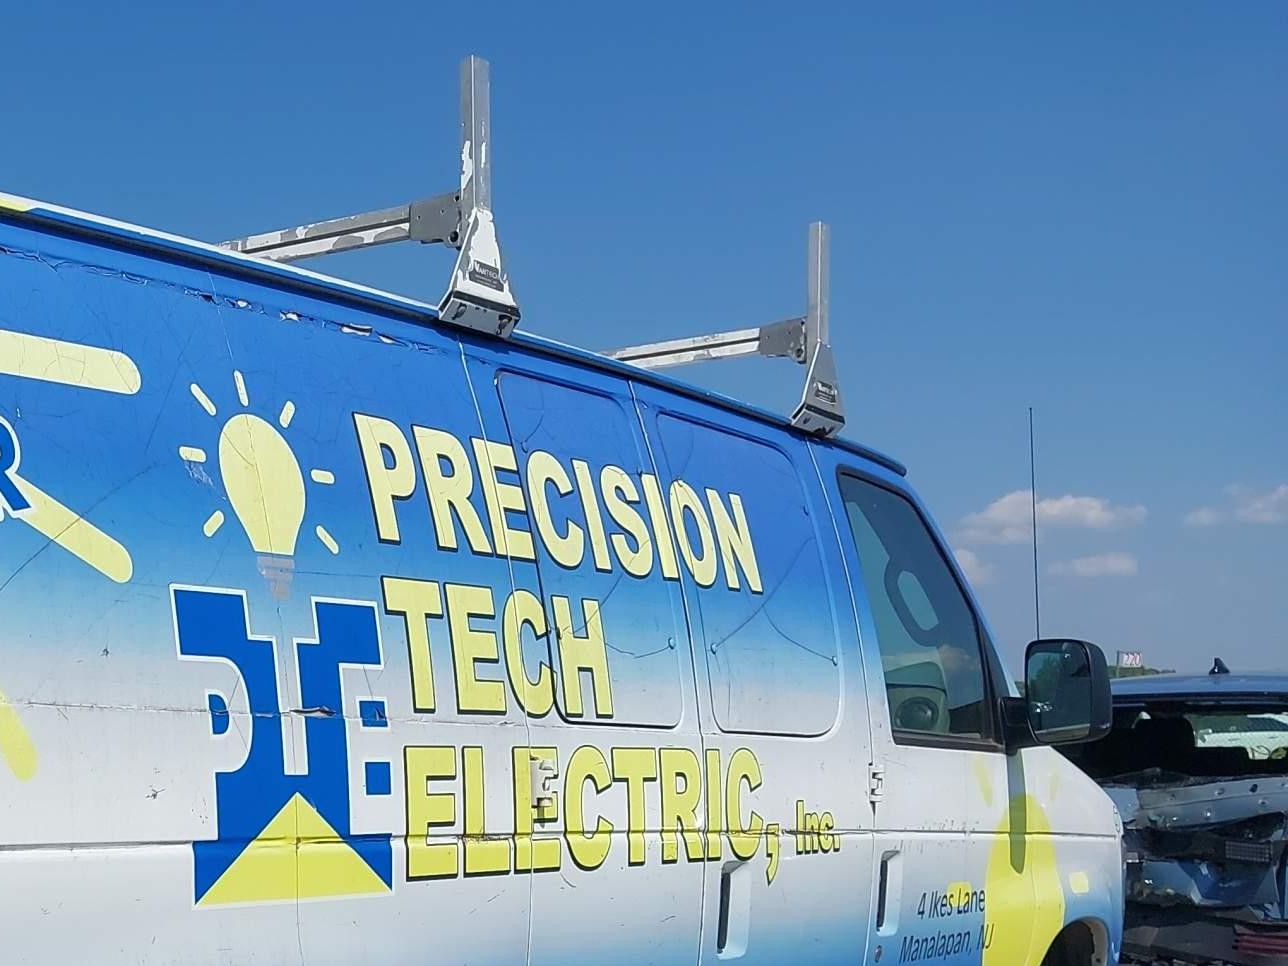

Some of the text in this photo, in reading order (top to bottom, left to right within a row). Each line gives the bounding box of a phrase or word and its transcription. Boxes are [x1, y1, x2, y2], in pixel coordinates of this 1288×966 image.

[352, 411, 764, 594] PRECISION
[380, 576, 614, 720] TECH
[403, 745, 842, 887] ELECTRIC, Inc.
[898, 923, 996, 965] Manalapan, NJ
[917, 888, 987, 920] 4 Ikes Lane
